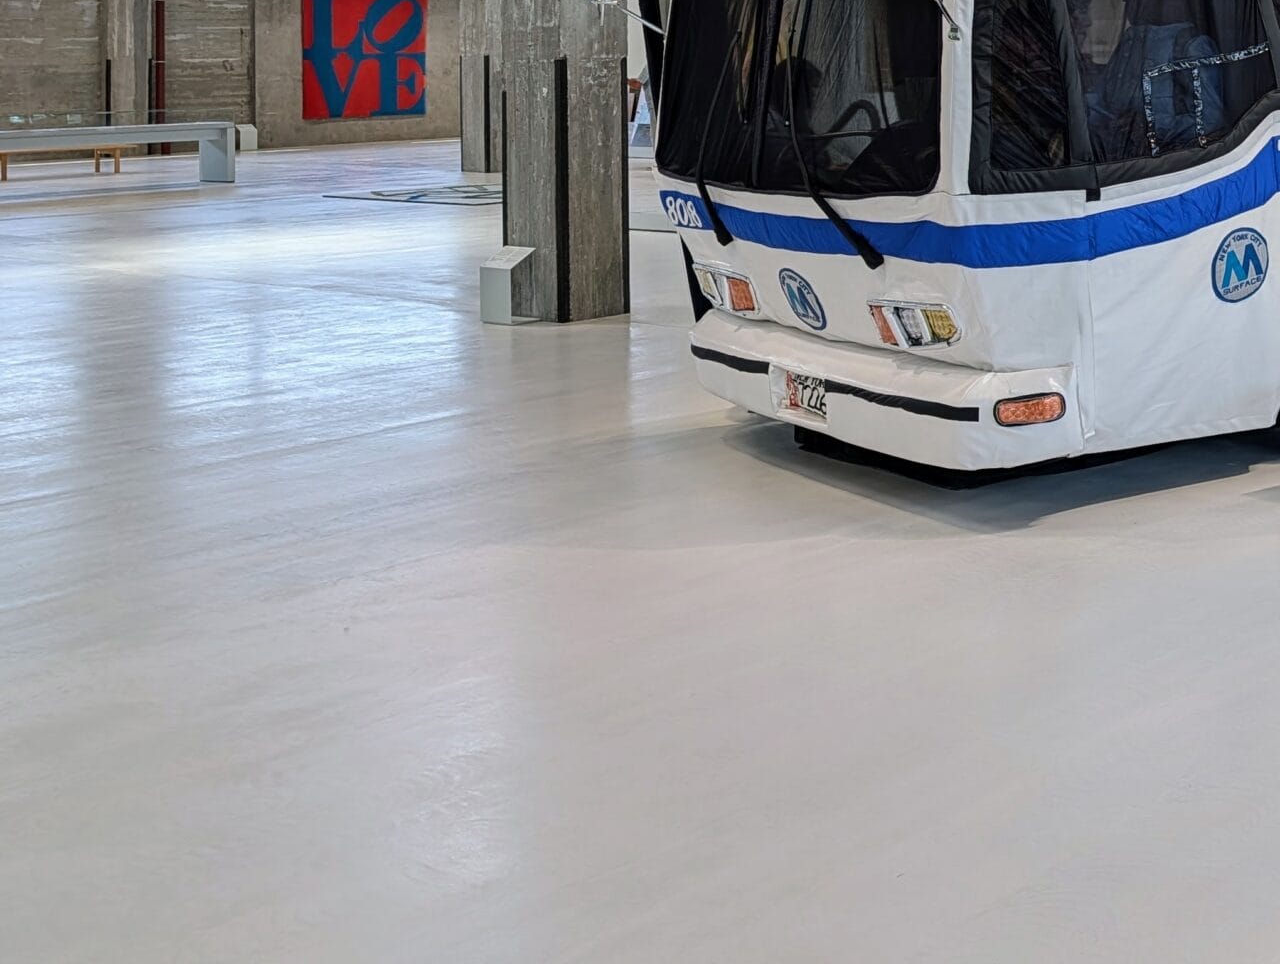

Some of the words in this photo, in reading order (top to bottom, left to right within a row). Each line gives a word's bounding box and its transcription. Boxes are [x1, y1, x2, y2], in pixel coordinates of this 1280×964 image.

[1219, 240, 1231, 262] NEW
[1232, 233, 1249, 243] YORK
[1250, 234, 1262, 247] CITY
[1222, 275, 1261, 295] SURFACE
